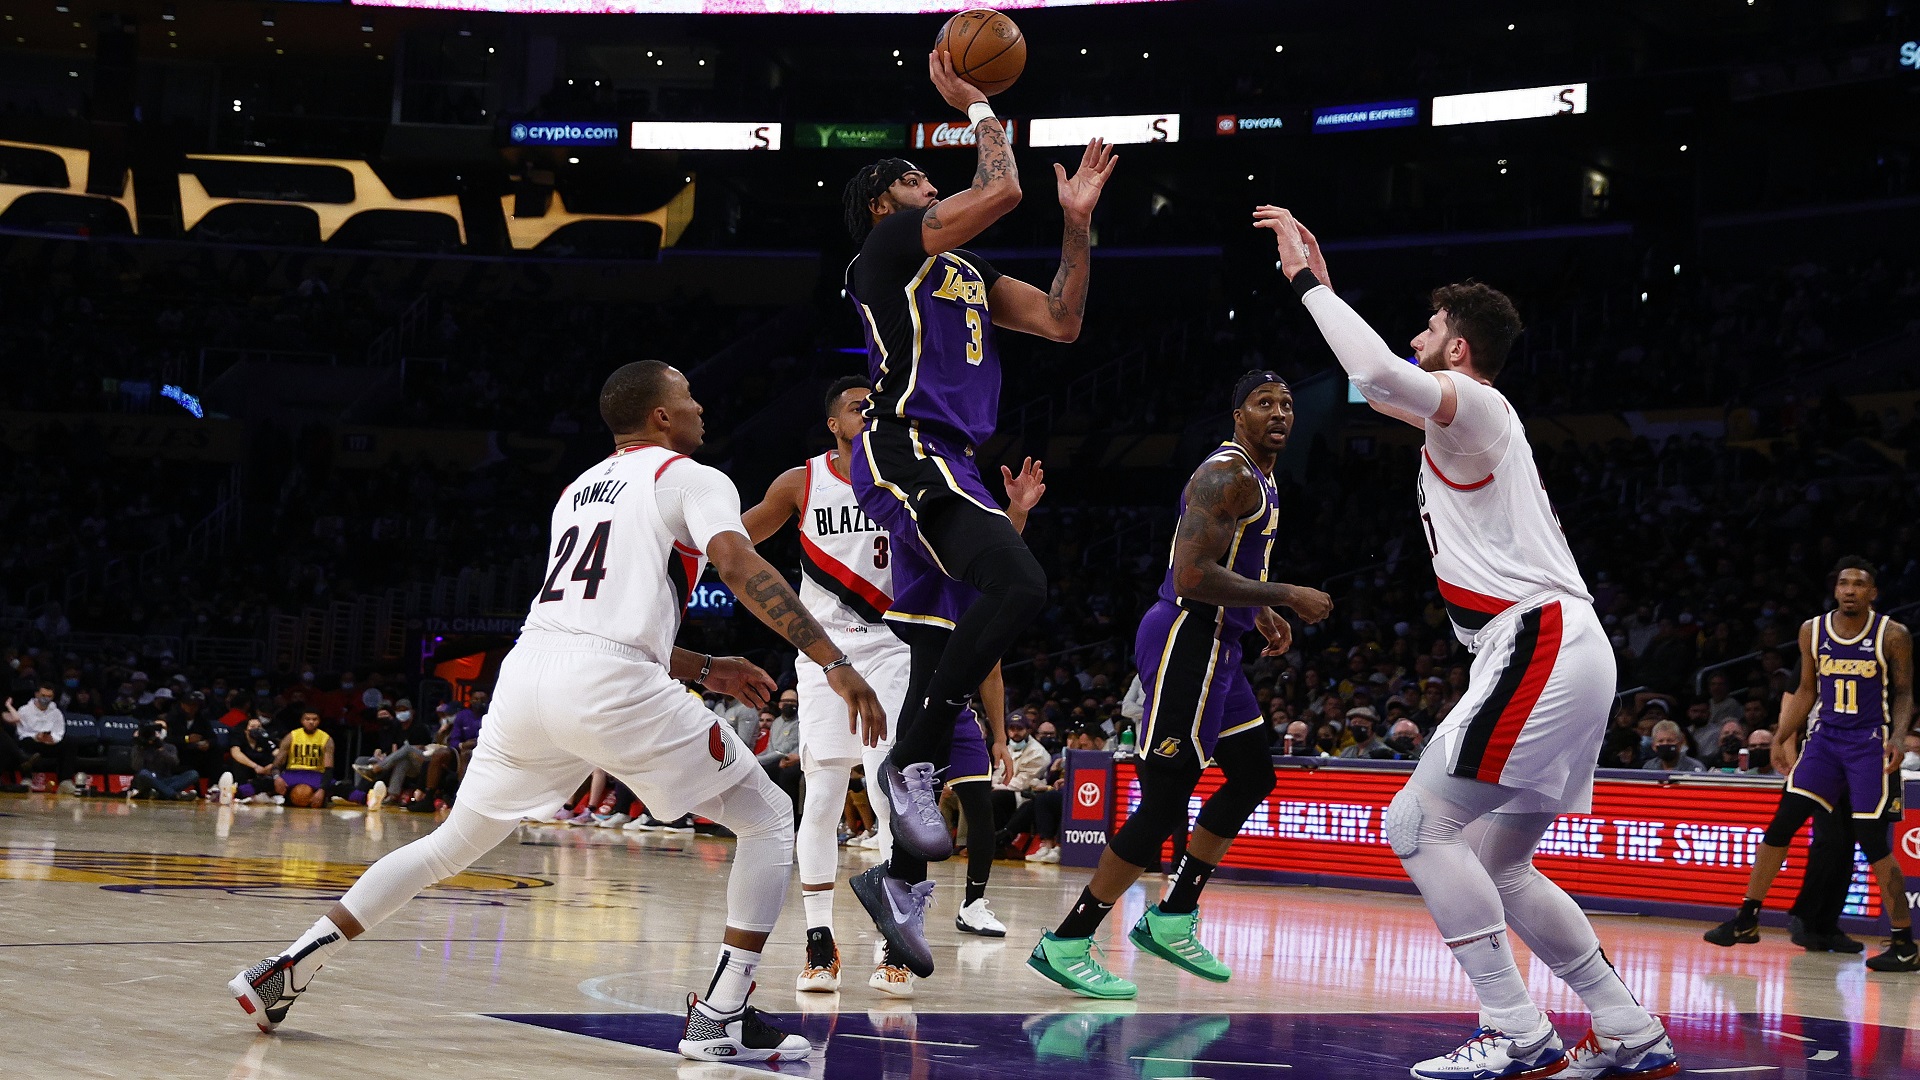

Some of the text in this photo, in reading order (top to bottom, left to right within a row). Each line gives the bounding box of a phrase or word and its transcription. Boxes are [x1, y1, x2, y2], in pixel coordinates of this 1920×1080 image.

[1237, 117, 1283, 130] TOYOTA
[1316, 107, 1415, 126] AMERICAN EXPRESS
[528, 124, 619, 143] crypto.com
[966, 307, 984, 366] 3
[573, 479, 628, 512] POWELL
[538, 519, 613, 604] 24
[873, 535, 889, 570] 3
[845, 625, 868, 634] ripcity
[1819, 654, 1878, 678] LAKERS
[1834, 678, 1858, 714] 11
[1065, 830, 1107, 844] TOYOTA
[1278, 801, 1376, 844] HEALTHY.
[1612, 819, 1665, 863] THE
